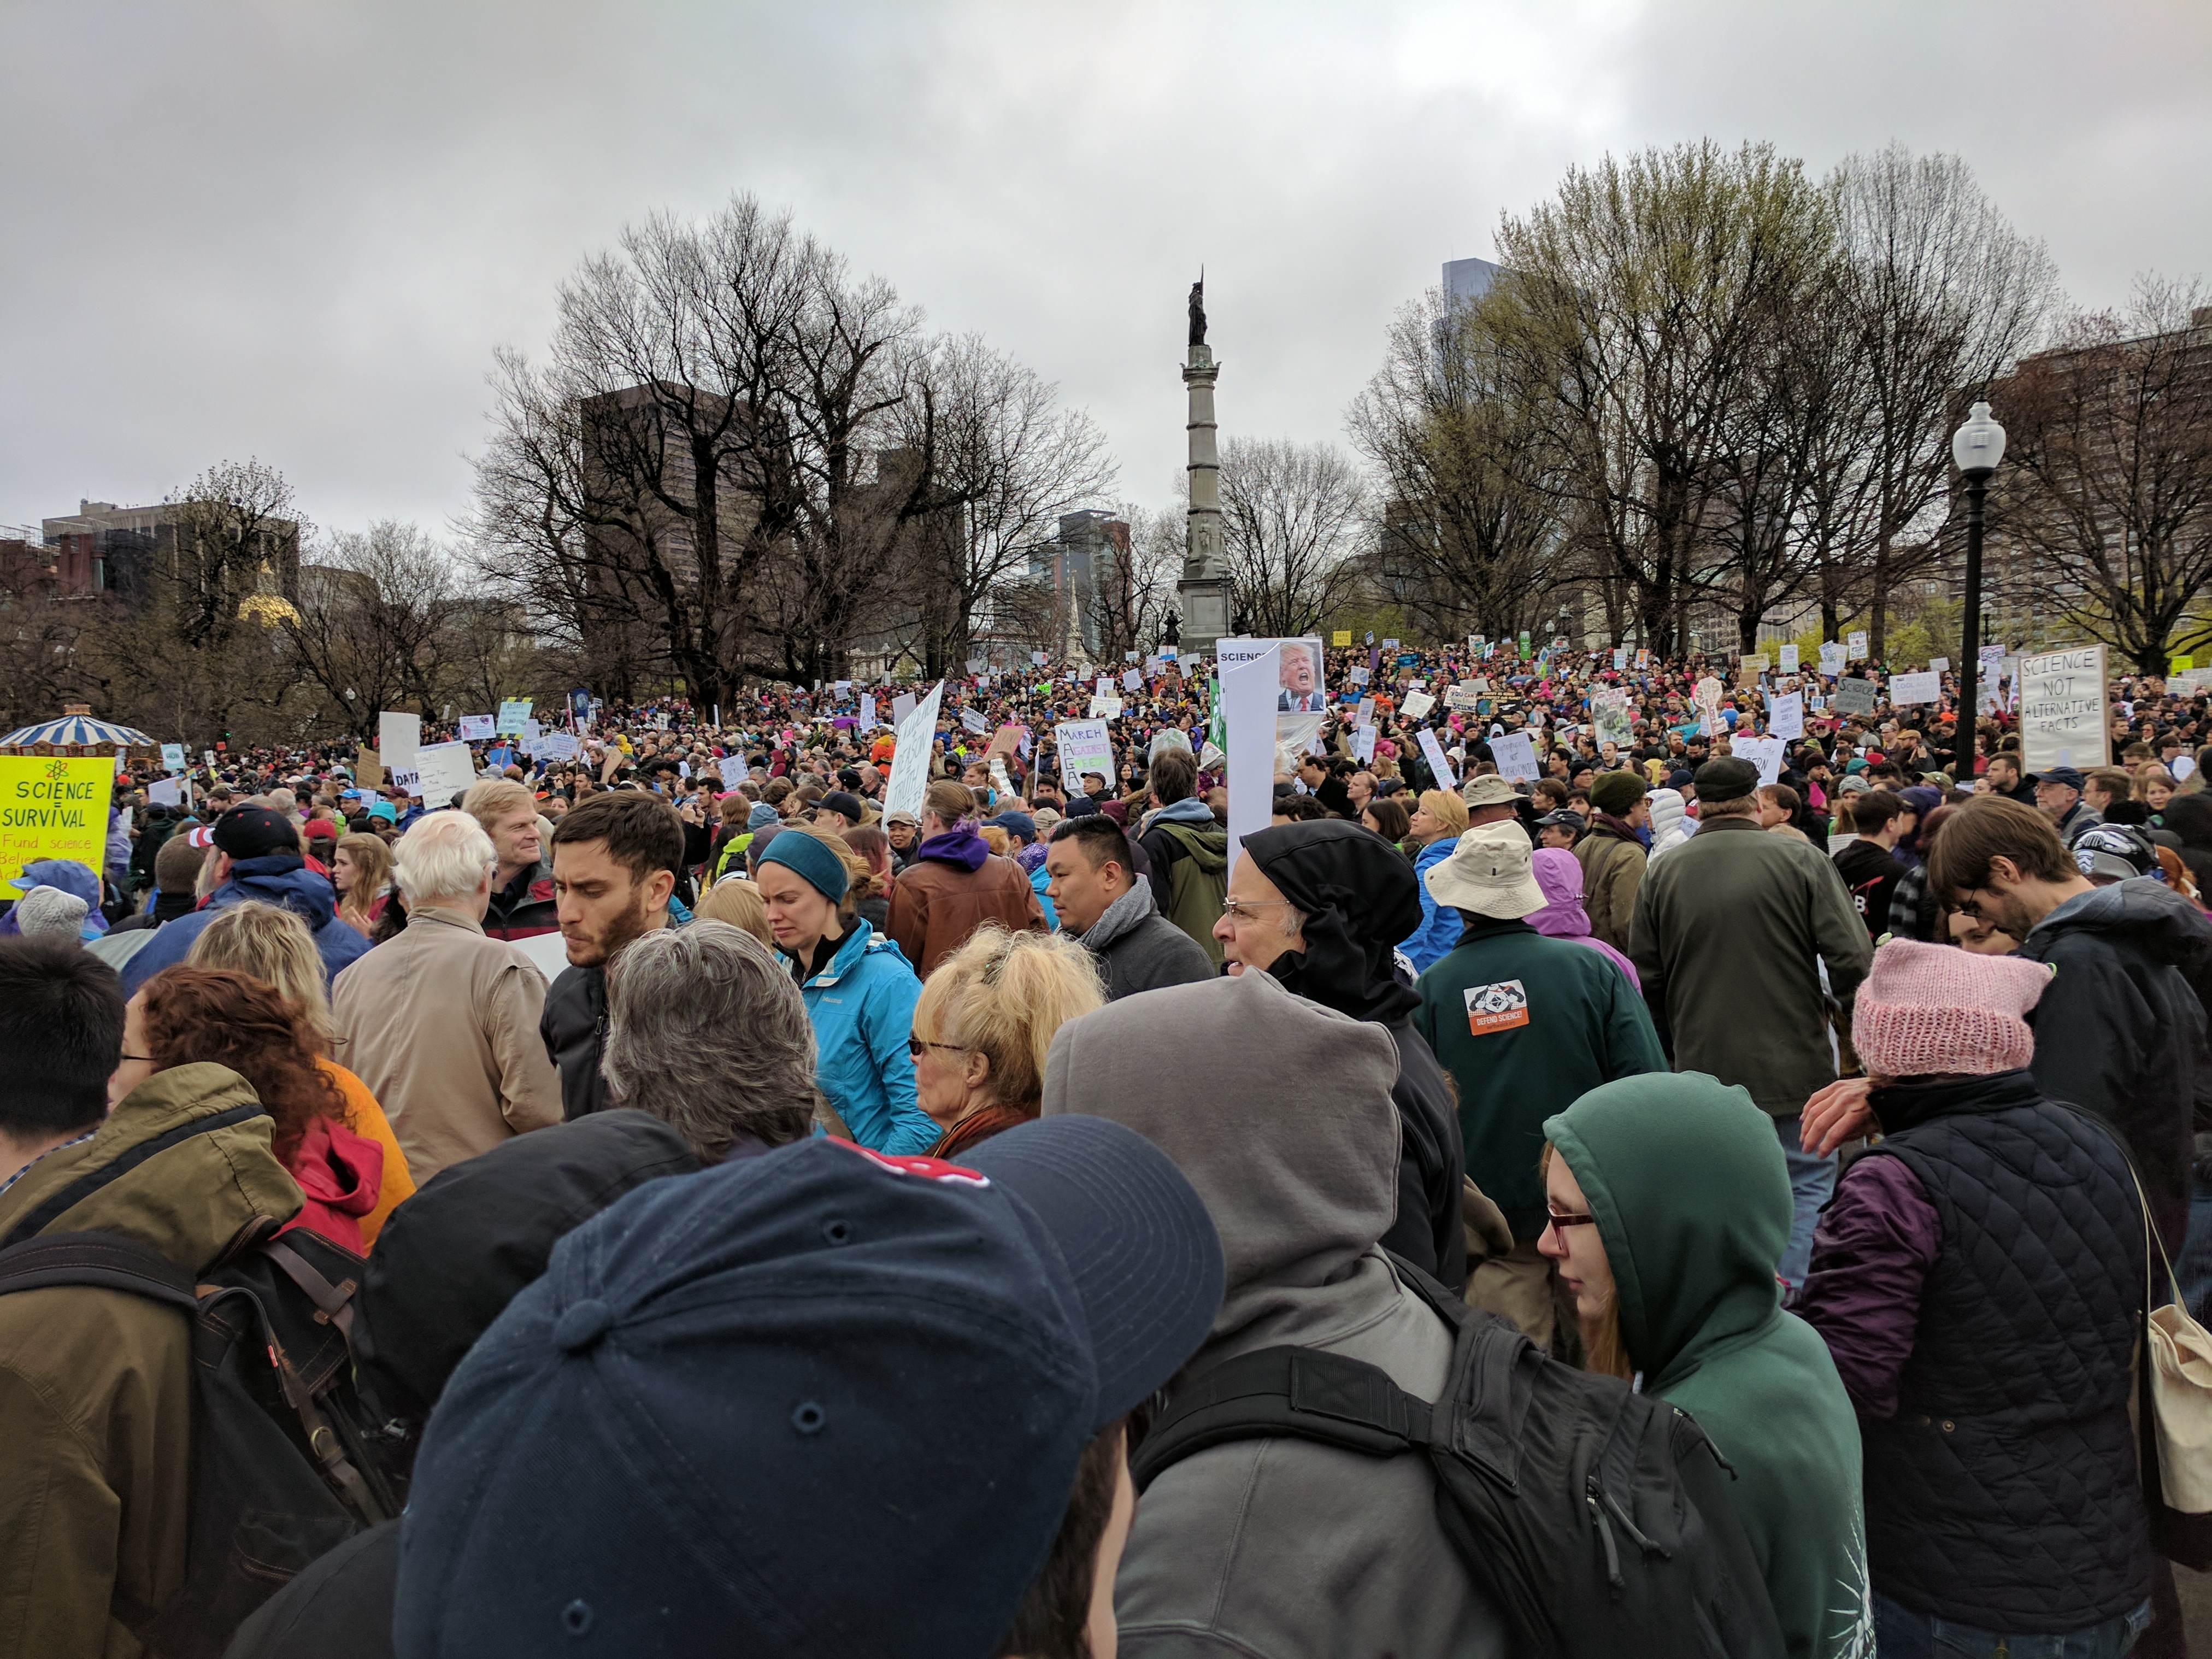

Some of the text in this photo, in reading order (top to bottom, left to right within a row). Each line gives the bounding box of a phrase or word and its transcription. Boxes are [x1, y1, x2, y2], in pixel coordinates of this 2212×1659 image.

[1221, 653, 1267, 661] SCIENC
[1839, 679, 1874, 696] Science
[2043, 677, 2075, 696] NOT
[964, 707, 983, 721] PROTECT
[1452, 703, 1476, 711] SCIENC
[2025, 698, 2099, 719] ALTERNATIVE
[897, 685, 940, 746] EVIDENCE
[2041, 716, 2079, 733] FACTS
[1060, 729, 1102, 740] MARCH
[895, 728, 928, 780] REASON
[1064, 743, 1107, 756] AGAINST
[1510, 753, 1518, 761] NOT
[1064, 758, 1108, 770] GREEDY
[396, 772, 419, 786] DATA
[893, 764, 920, 809] TRUTH
[16, 781, 95, 799] SCIENCE
[2, 808, 86, 827] SURVIVAL
[3, 834, 91, 849] Fund science
[1476, 1010, 1522, 1026] DEFEND SCIENCE!
